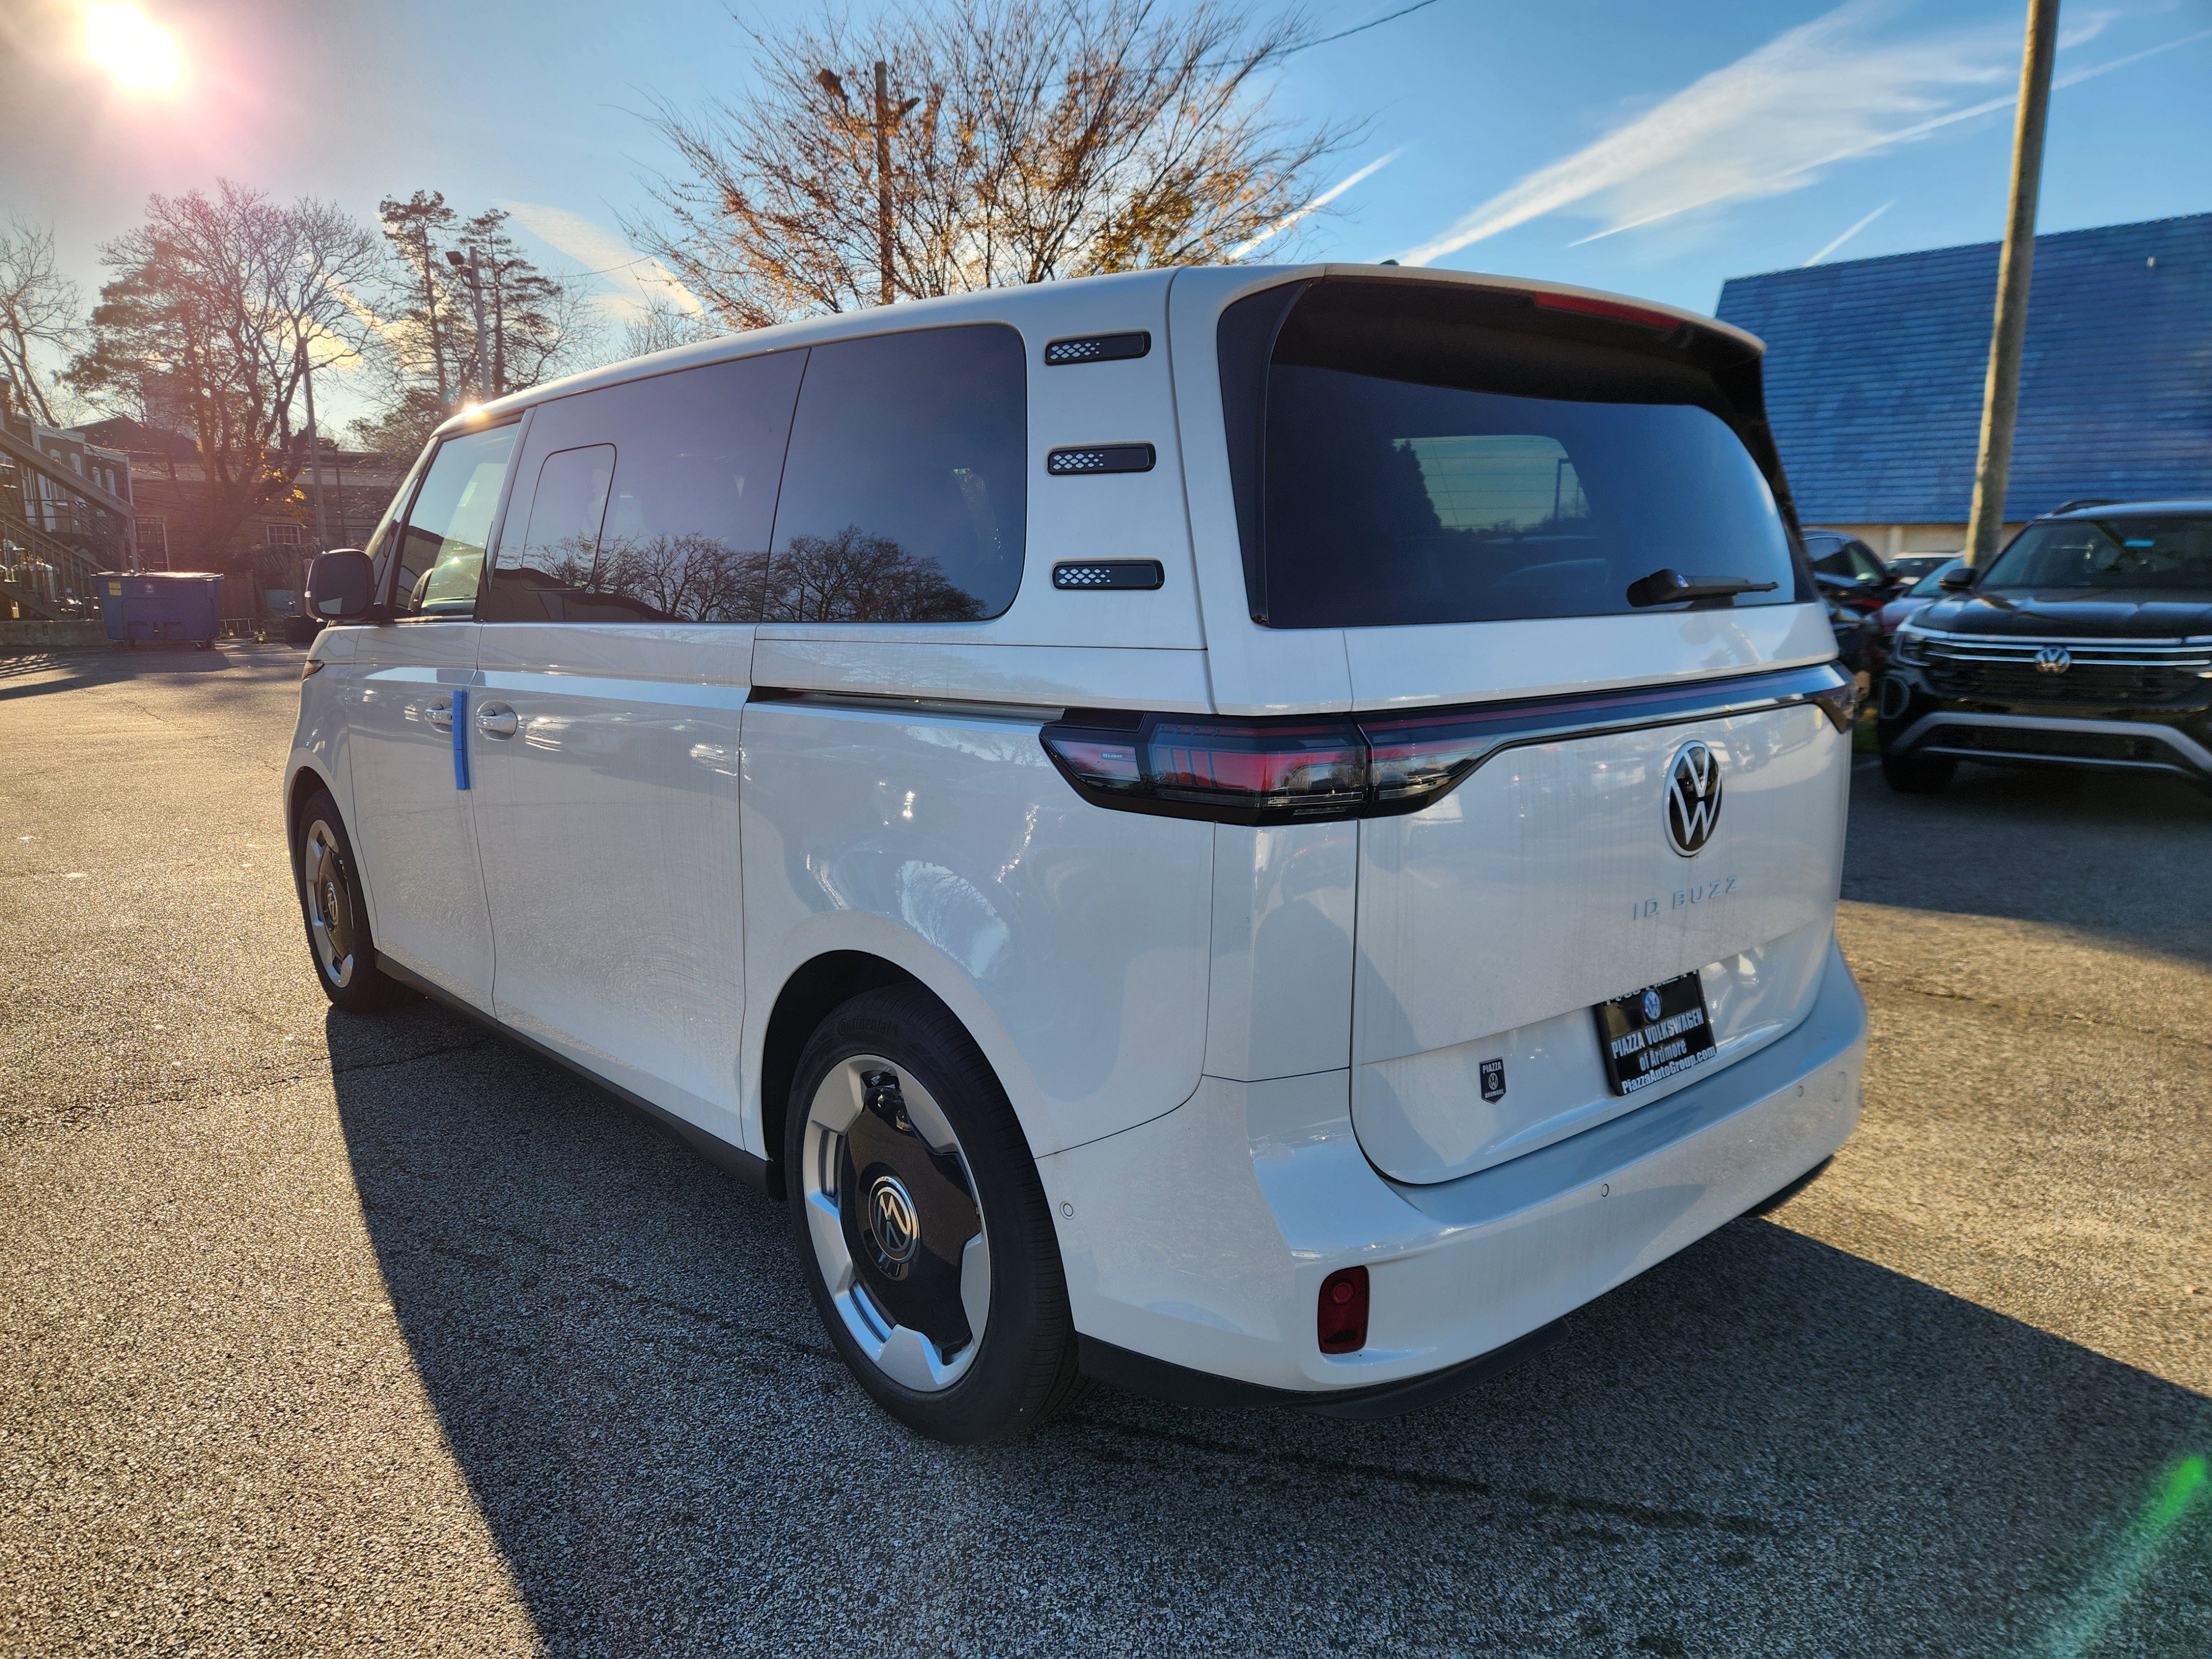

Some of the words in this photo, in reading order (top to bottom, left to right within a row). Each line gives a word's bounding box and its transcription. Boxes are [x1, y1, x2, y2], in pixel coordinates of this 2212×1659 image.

[1668, 745, 1721, 848] VW
[1634, 898, 1658, 920] ID
[1673, 875, 1738, 910] BUZZ
[1611, 1031, 1645, 1059] PIAZZA
[1645, 1008, 1704, 1045] VOLKSWAGEN
[1640, 1052, 1649, 1071] of
[1650, 1040, 1687, 1067] Ardmore
[1483, 1061, 1503, 1074] PIAZZA
[1621, 1046, 1716, 1094] PiazzaAutoGroup.com
